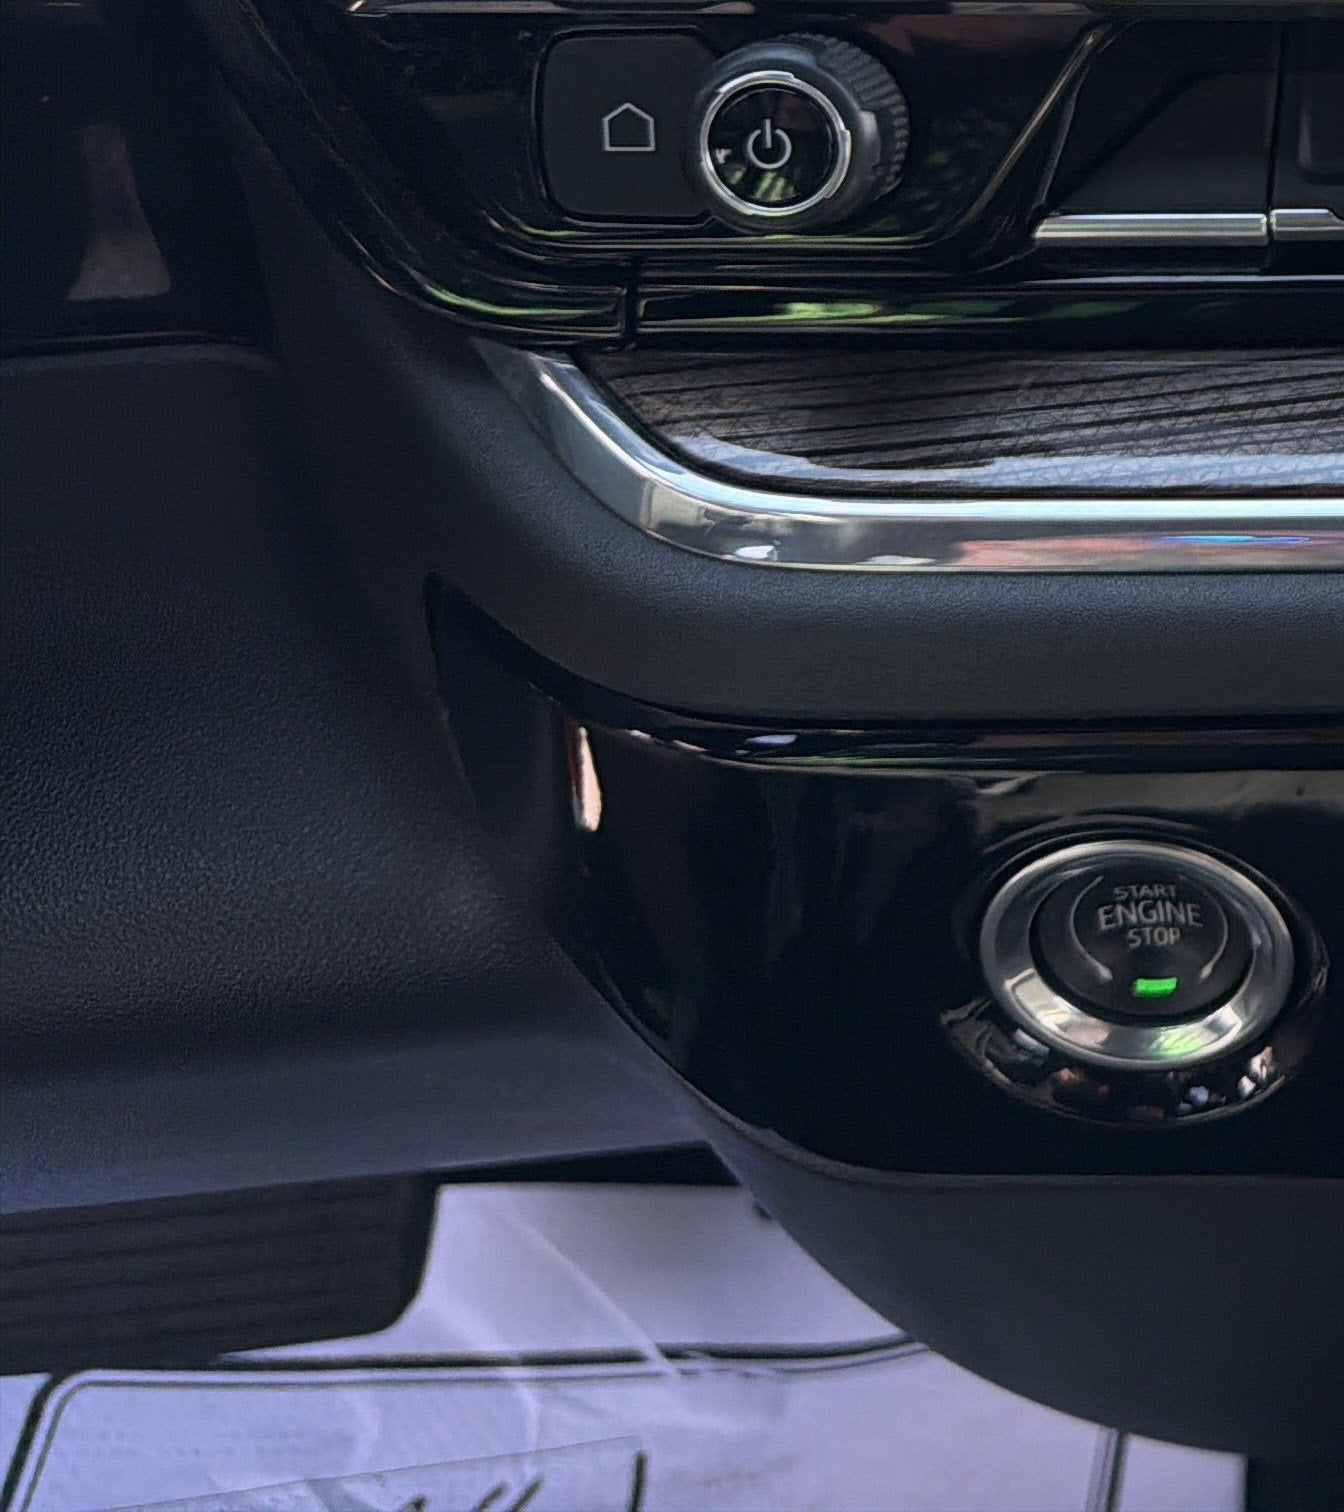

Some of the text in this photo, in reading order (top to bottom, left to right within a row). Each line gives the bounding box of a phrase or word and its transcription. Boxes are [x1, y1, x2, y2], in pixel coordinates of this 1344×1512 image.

[1113, 884, 1176, 900] START
[1097, 899, 1204, 931] ENGINE
[1126, 927, 1181, 948] STOP
